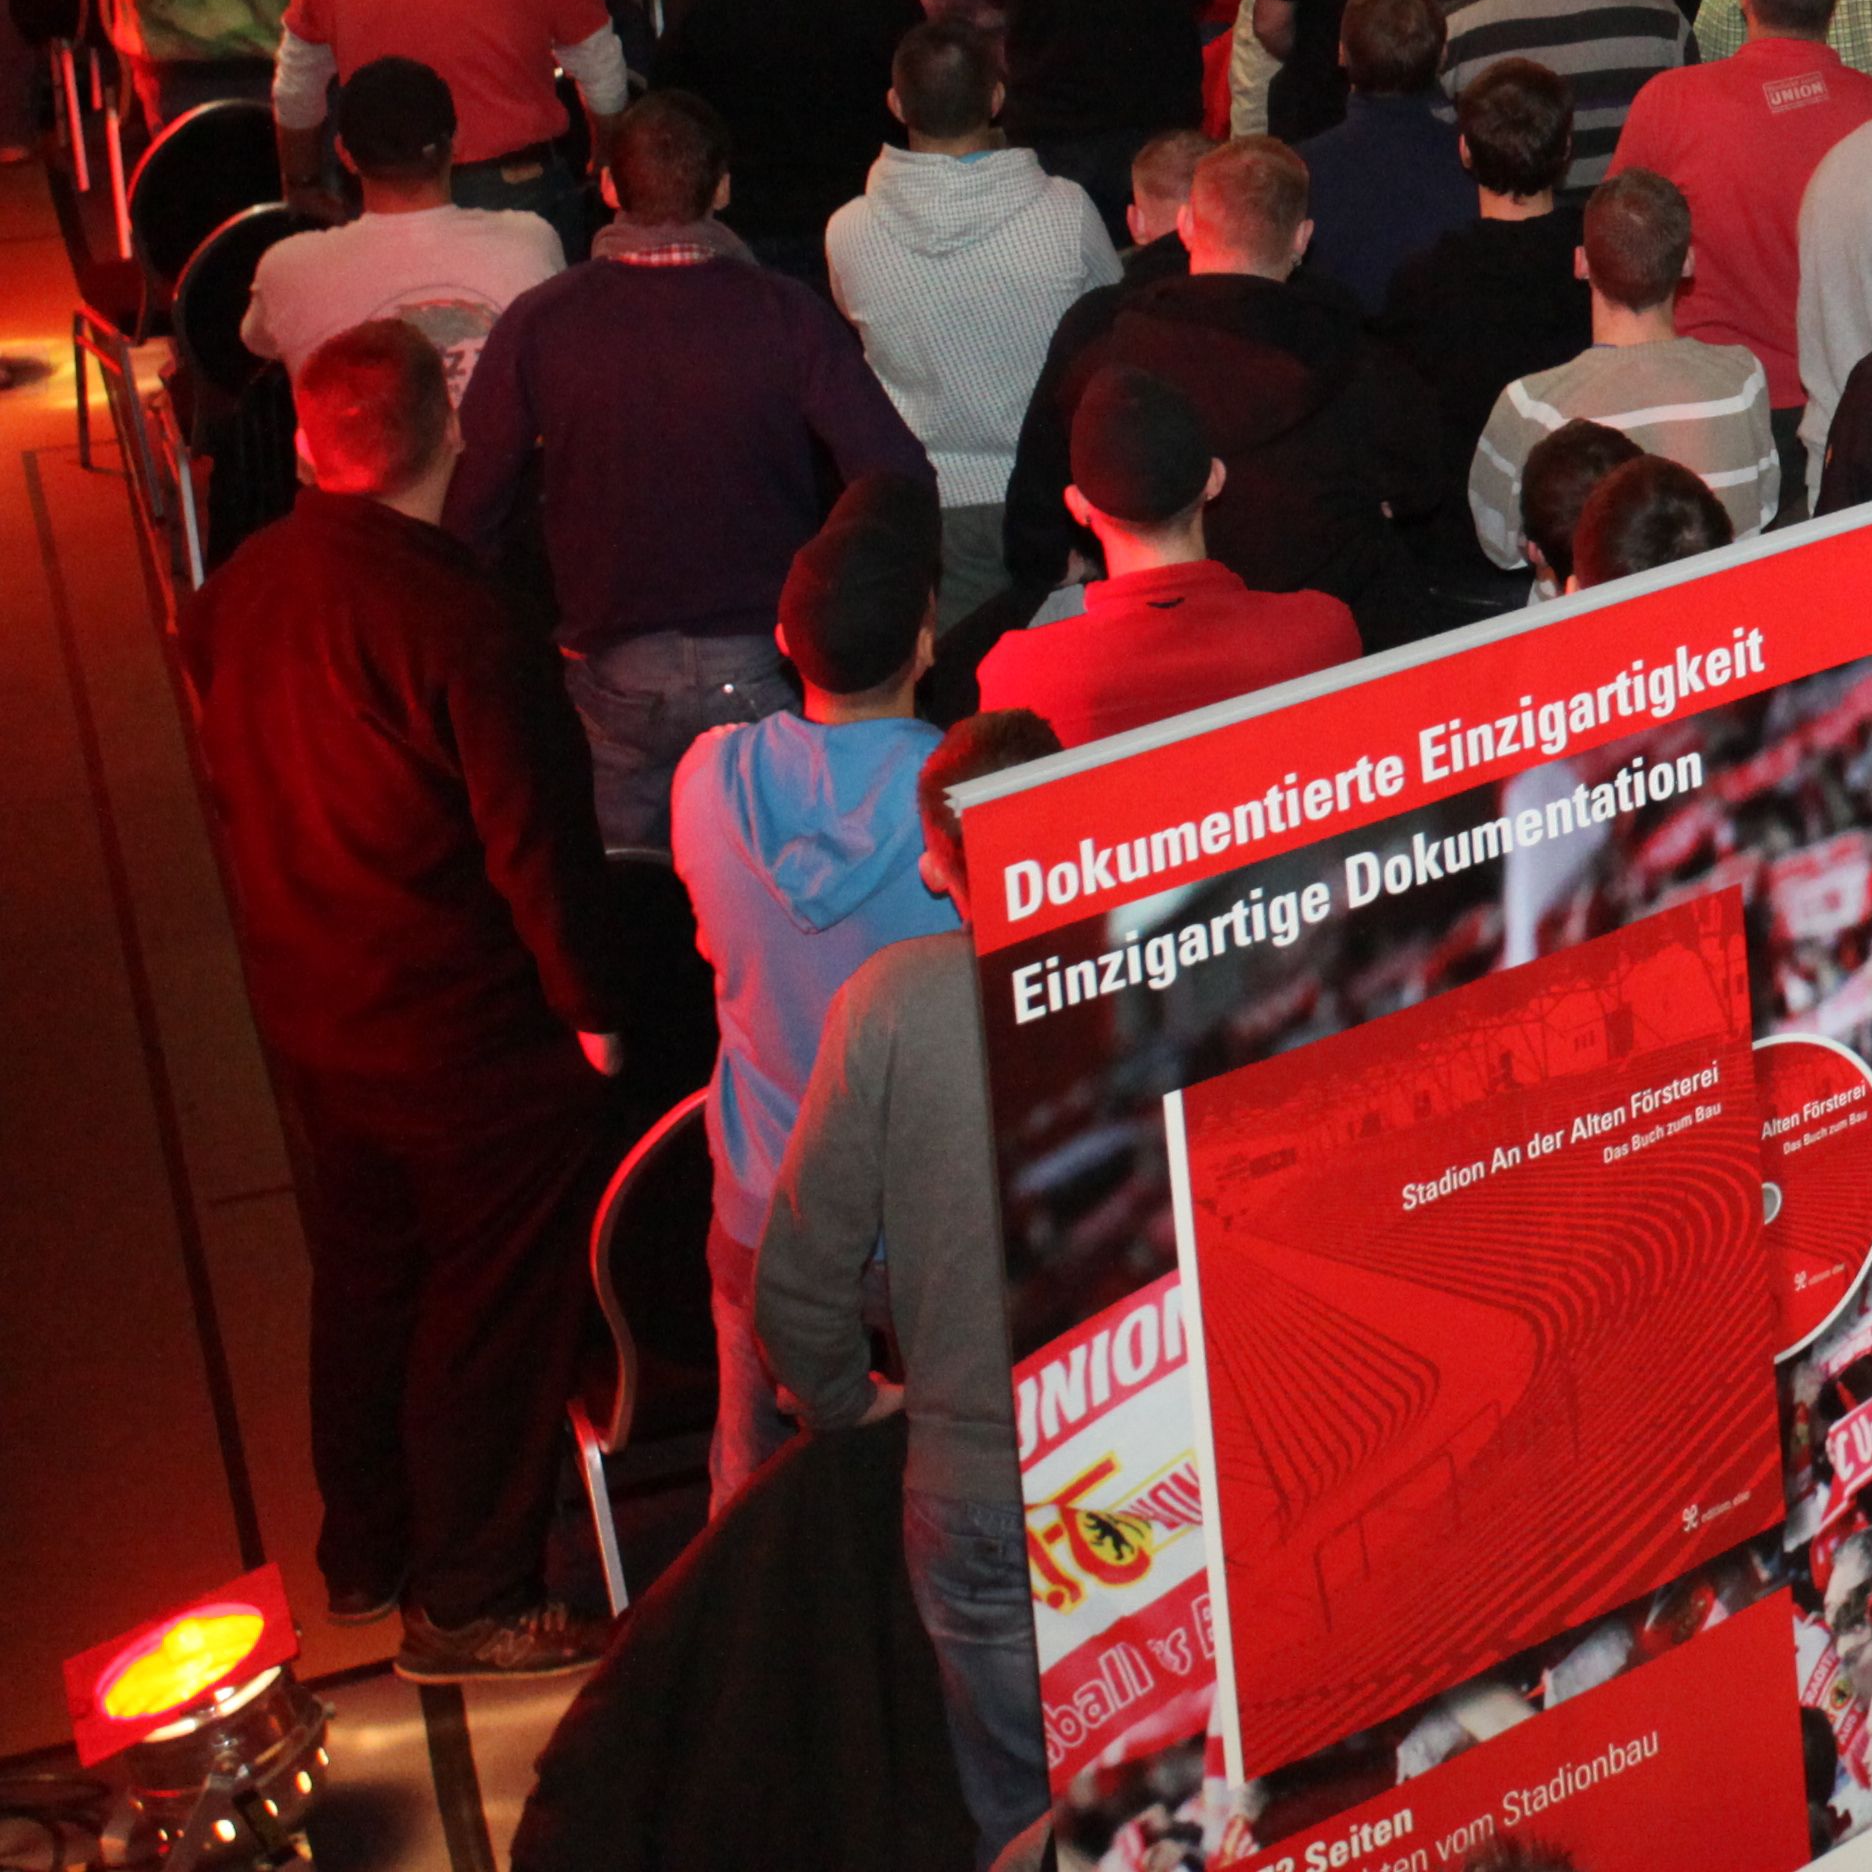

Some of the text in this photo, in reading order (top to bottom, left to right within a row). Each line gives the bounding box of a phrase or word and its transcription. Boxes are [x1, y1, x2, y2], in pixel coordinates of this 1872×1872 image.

[1770, 81, 1825, 106] UNION
[1003, 626, 1765, 923] Dokumentierte Einzigartigkeit
[1011, 750, 1703, 1025] Einzigartige Dokumentation
[1401, 1061, 1720, 1211] Stadion An der Alten Försterei
[1603, 1102, 1722, 1164] Das Buch zum Bau
[1761, 1080, 1868, 1140] Alten Försterei
[1783, 1137, 1802, 1156] Das
[1803, 1128, 1828, 1146] Buch
[1849, 1110, 1868, 1126] Bau
[1434, 1730, 1659, 1861] vom Stadionbau
[1304, 1807, 1413, 1872] Seiten
